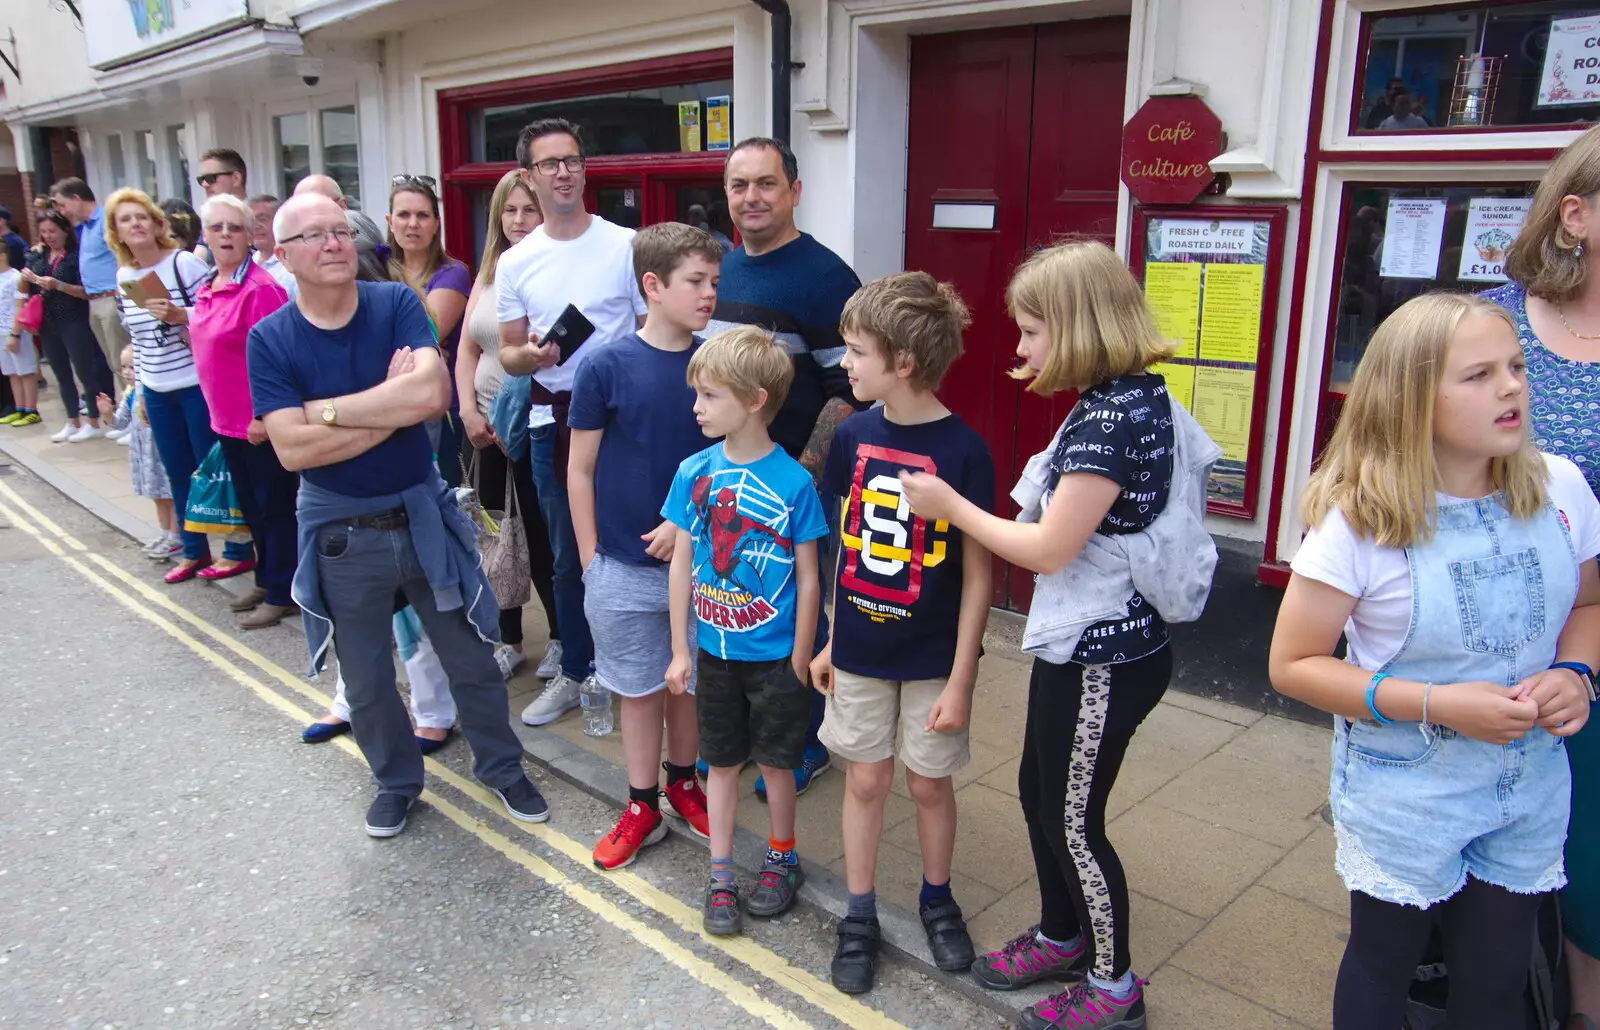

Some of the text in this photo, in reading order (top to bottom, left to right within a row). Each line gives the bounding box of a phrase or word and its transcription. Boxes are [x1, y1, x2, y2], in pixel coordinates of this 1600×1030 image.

[1573, 57, 1600, 70] RO
[1586, 73, 1600, 85] D
[1148, 120, 1196, 146] Café
[1128, 157, 1208, 178] Culture
[1169, 228, 1200, 236] FRESH
[1168, 241, 1244, 250] ROASTED DAILY
[1085, 410, 1124, 421] SPIRIT
[699, 582, 753, 606] AMAZING
[692, 588, 775, 629] PIDER-MAN
[852, 596, 877, 610] NATIONAL
[878, 604, 907, 617] DIVISION
[1121, 614, 1153, 631] SPIRIT
